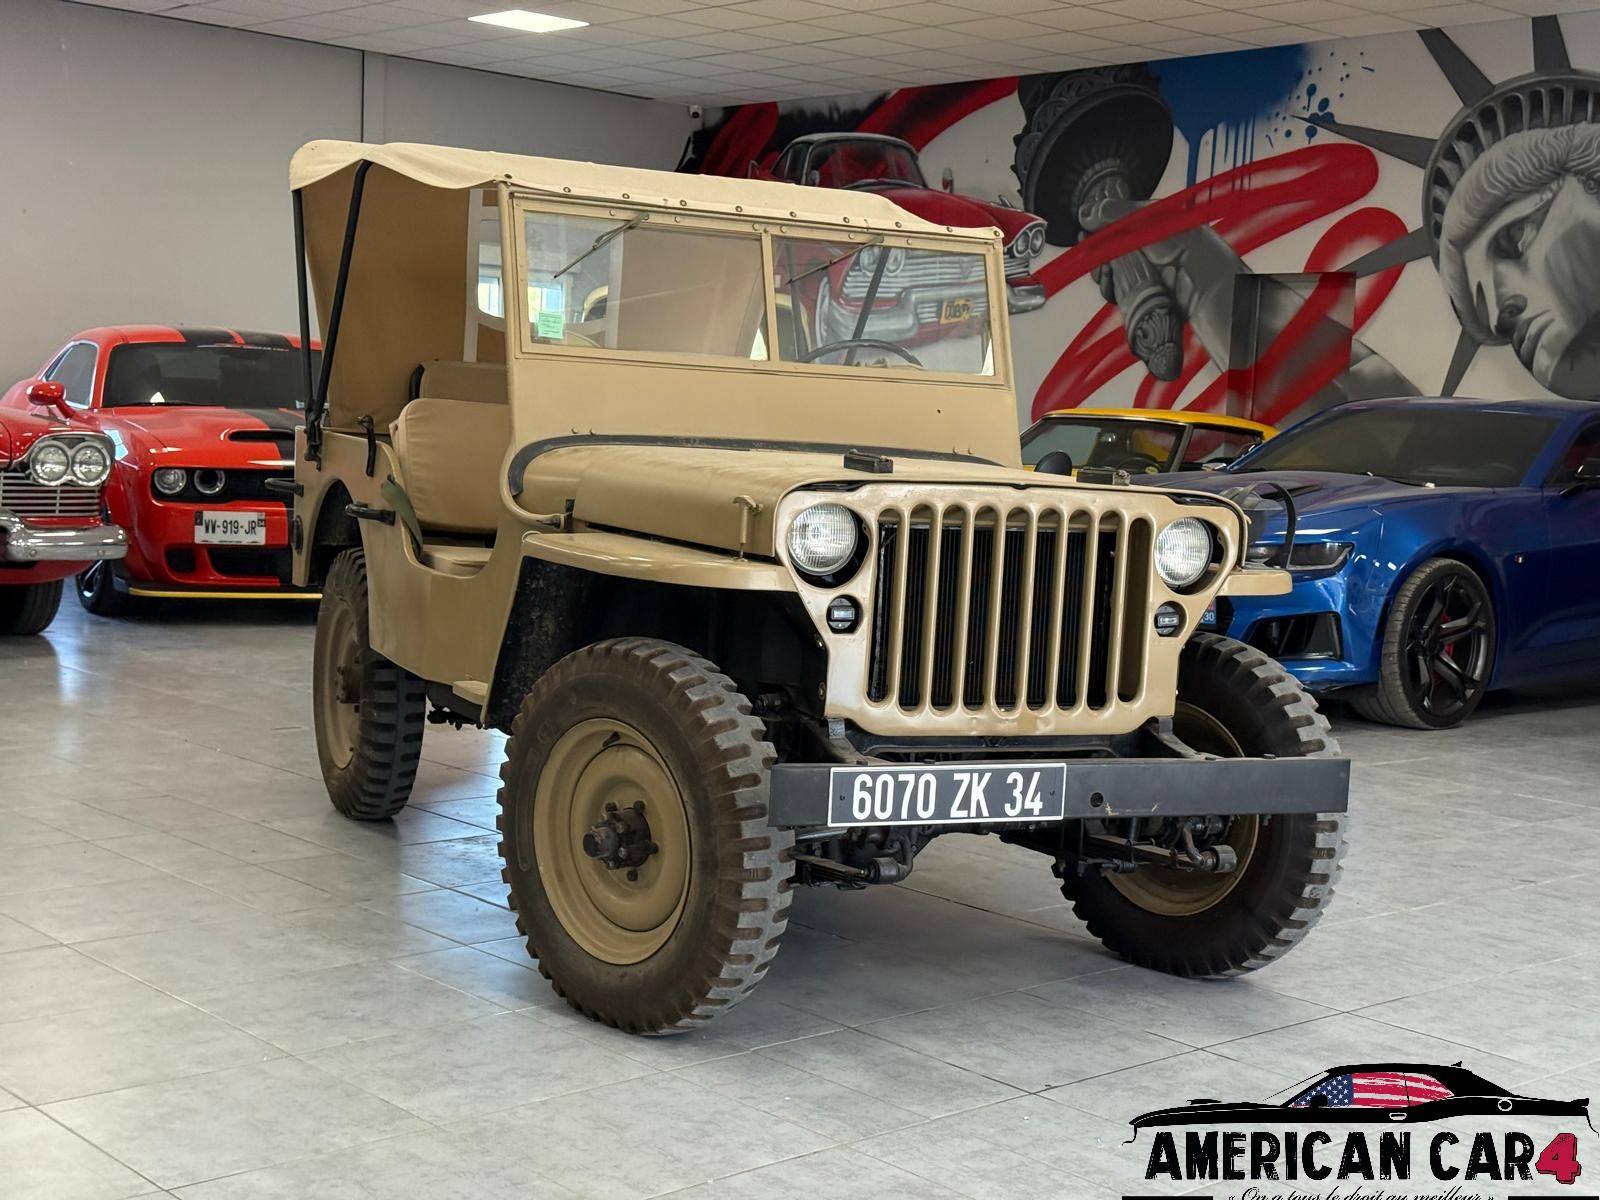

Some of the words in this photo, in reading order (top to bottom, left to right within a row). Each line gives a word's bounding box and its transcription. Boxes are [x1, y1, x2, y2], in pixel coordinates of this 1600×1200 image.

[852, 773, 937, 820] 6070
[950, 772, 992, 818] ZK
[1004, 771, 1043, 816] 34
